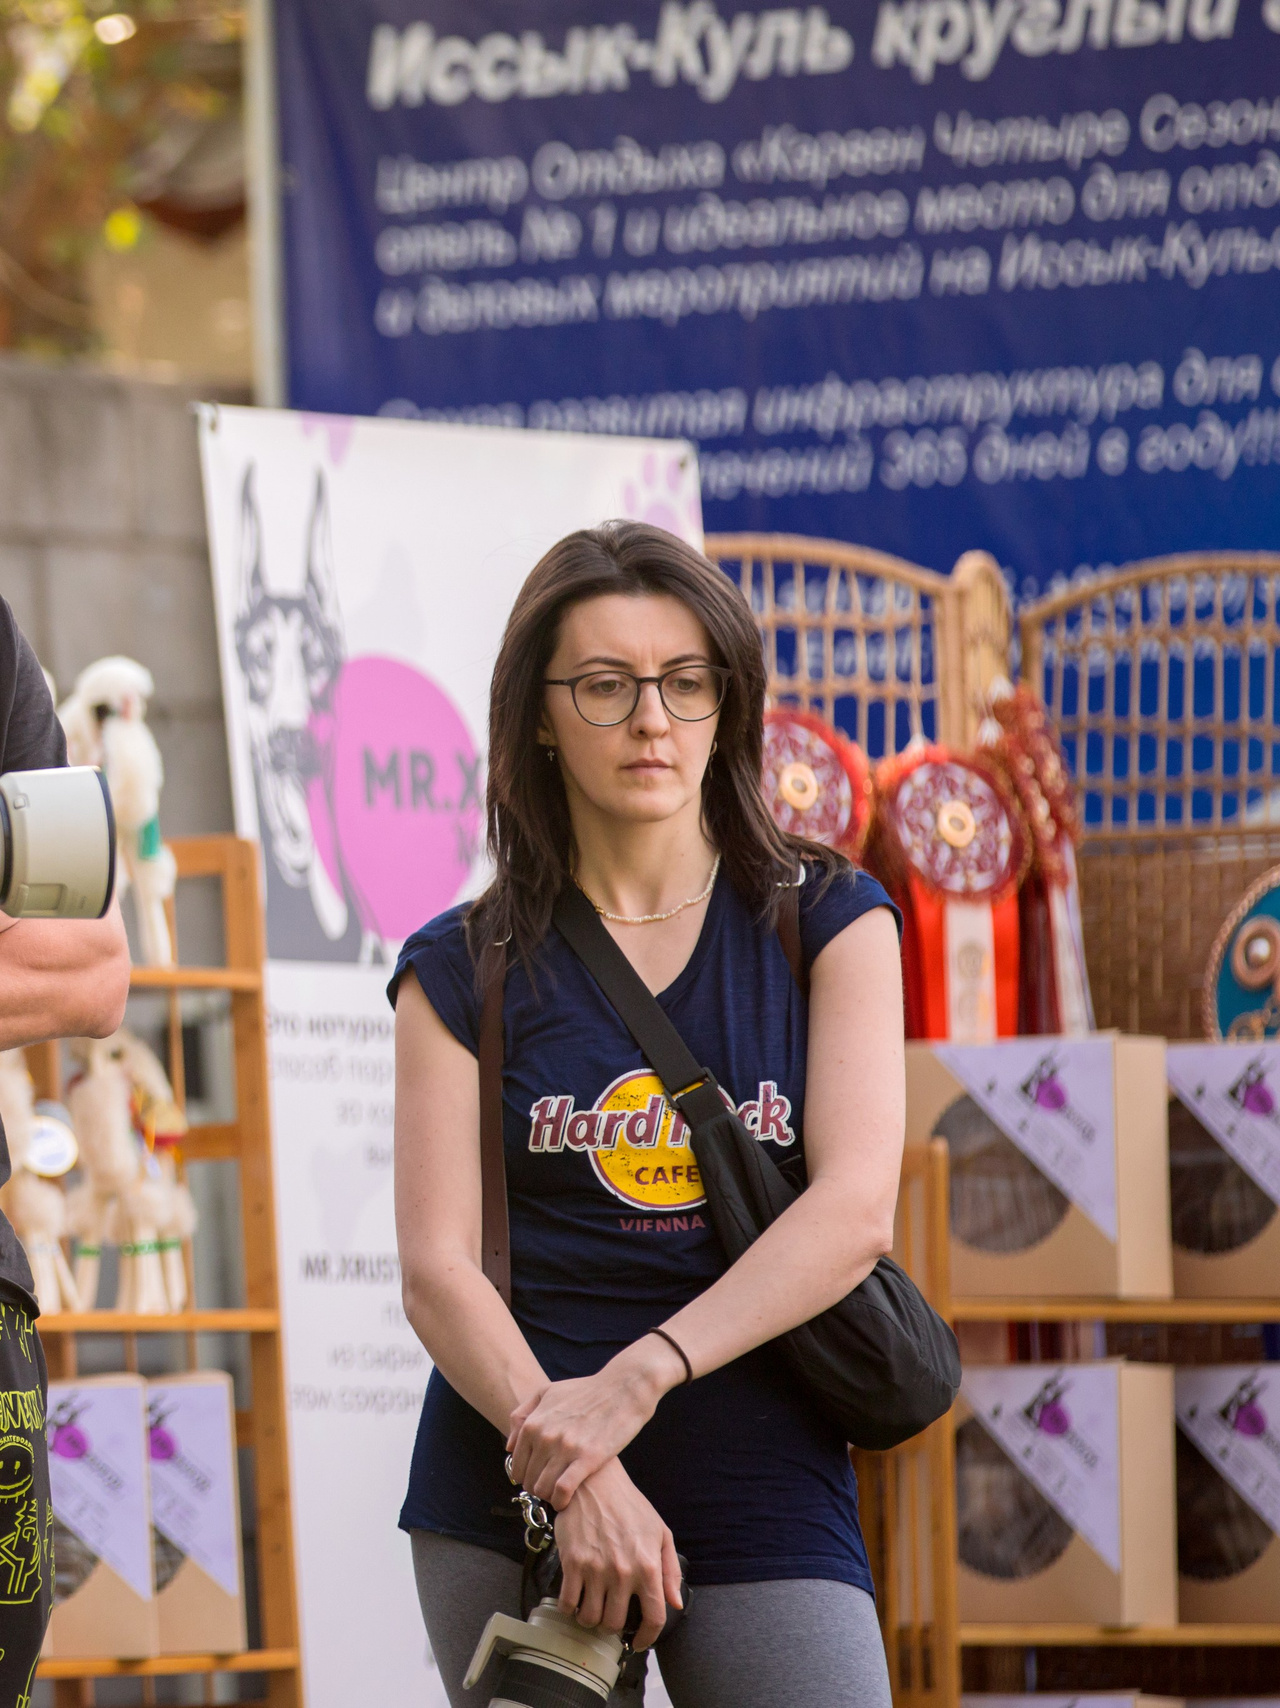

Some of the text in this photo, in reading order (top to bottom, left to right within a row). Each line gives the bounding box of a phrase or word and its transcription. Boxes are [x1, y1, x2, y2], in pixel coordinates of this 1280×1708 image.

[368, 0, 854, 111] Иссык-Куль
[374, 152, 529, 220] Центр
[532, 135, 726, 200] Отдыха
[933, 109, 1131, 171] Четыре
[374, 220, 517, 277] отель
[521, 204, 582, 264] №
[589, 202, 617, 260] 1
[623, 206, 660, 257] и
[663, 191, 909, 254] идеальное
[914, 176, 1075, 235] место
[1081, 161, 1170, 222] для
[374, 286, 413, 339] и
[416, 273, 599, 337] деловых
[603, 242, 923, 328] мероприятий
[929, 245, 991, 297] на
[753, 361, 1165, 444] инфраструктура
[1173, 346, 1263, 408] для
[878, 425, 968, 491] 365
[973, 420, 1090, 485] дней
[1096, 425, 1129, 477] в
[528, 1094, 664, 1152] Hard
[620, 1215, 706, 1232] VIENNA
[634, 1164, 701, 1186] CAFE
